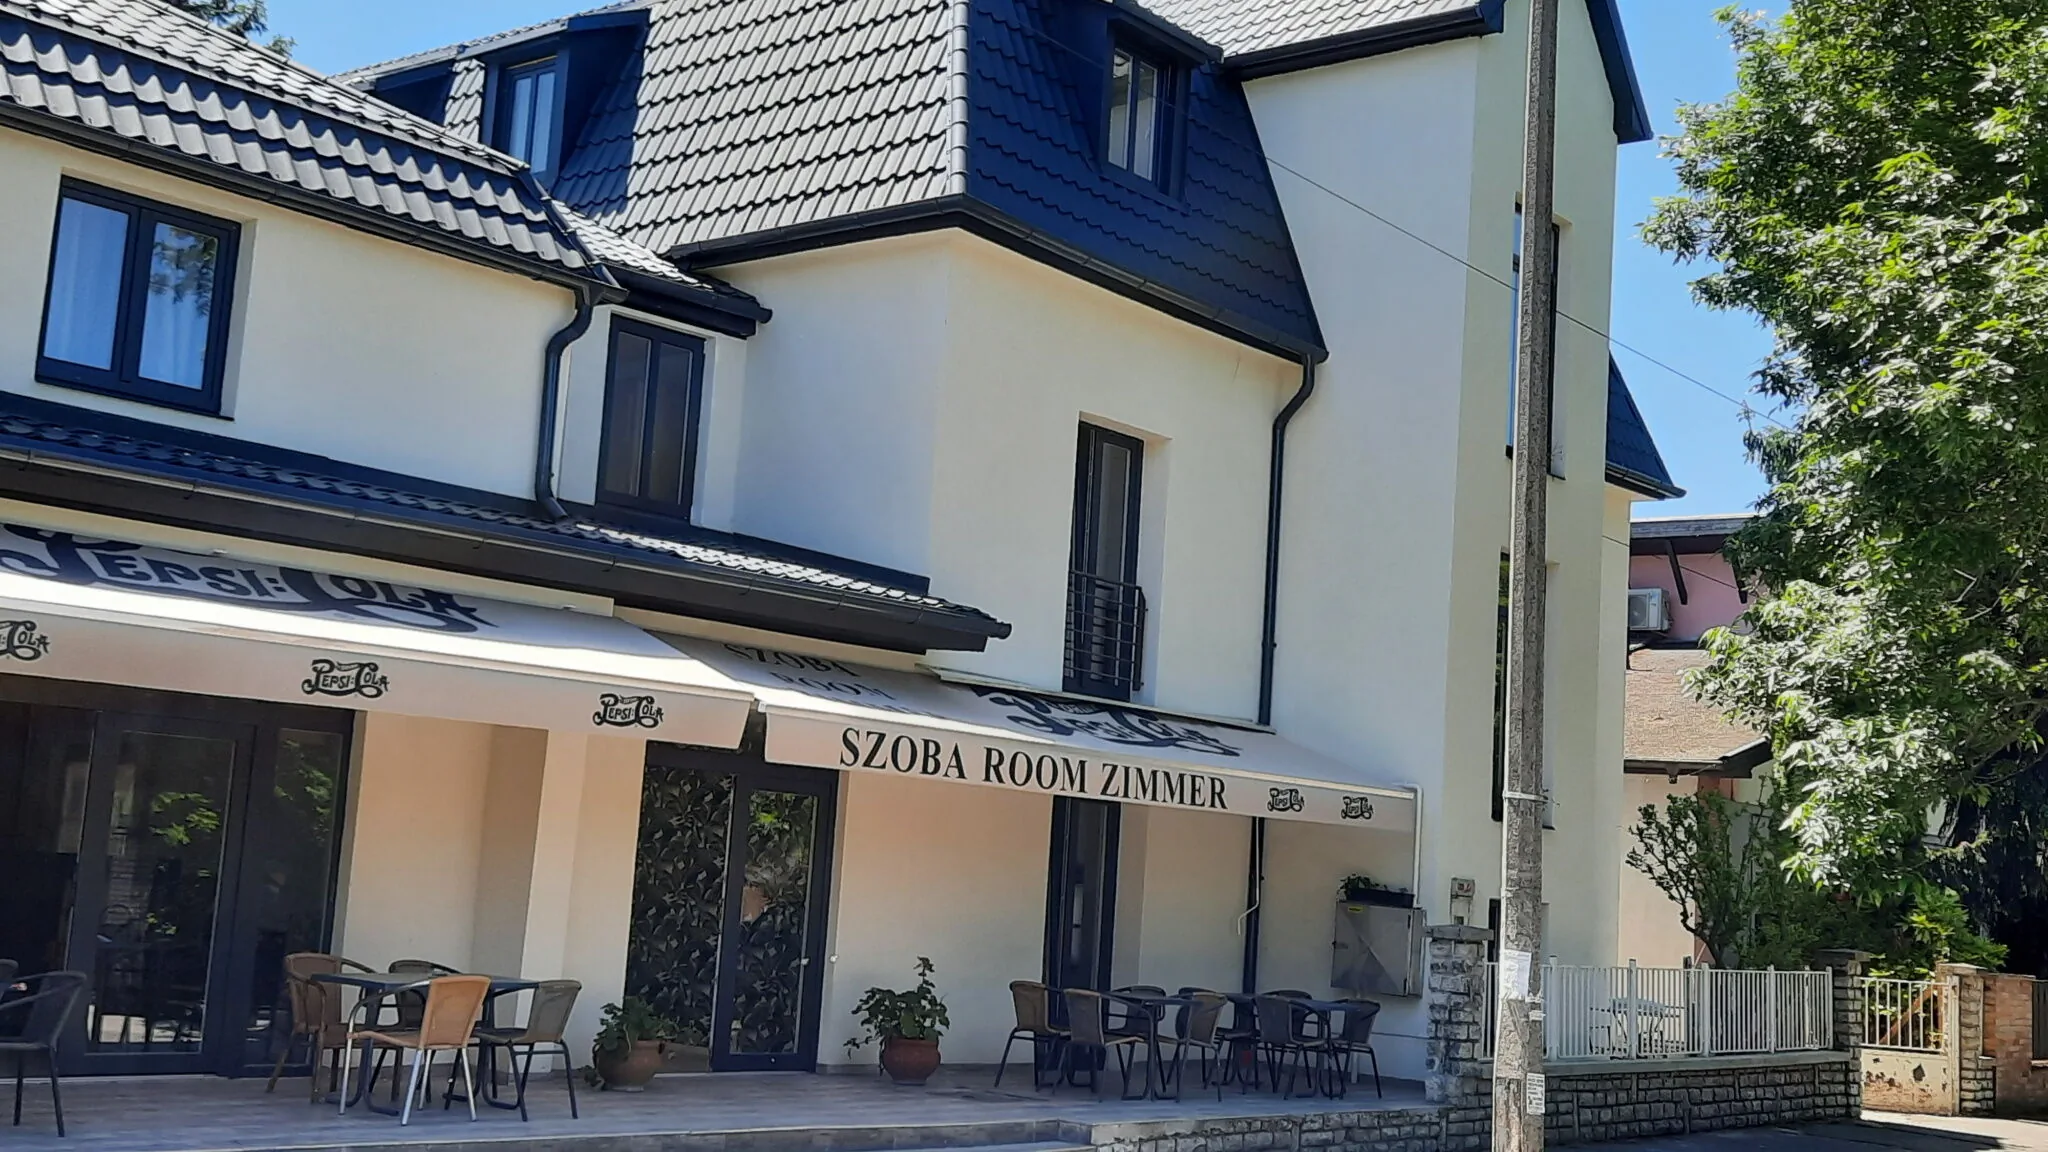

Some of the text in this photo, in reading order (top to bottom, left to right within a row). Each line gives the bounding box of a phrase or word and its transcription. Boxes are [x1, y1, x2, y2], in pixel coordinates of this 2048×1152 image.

[839, 727, 1229, 810] SZOBA ROOM ZIMMER
